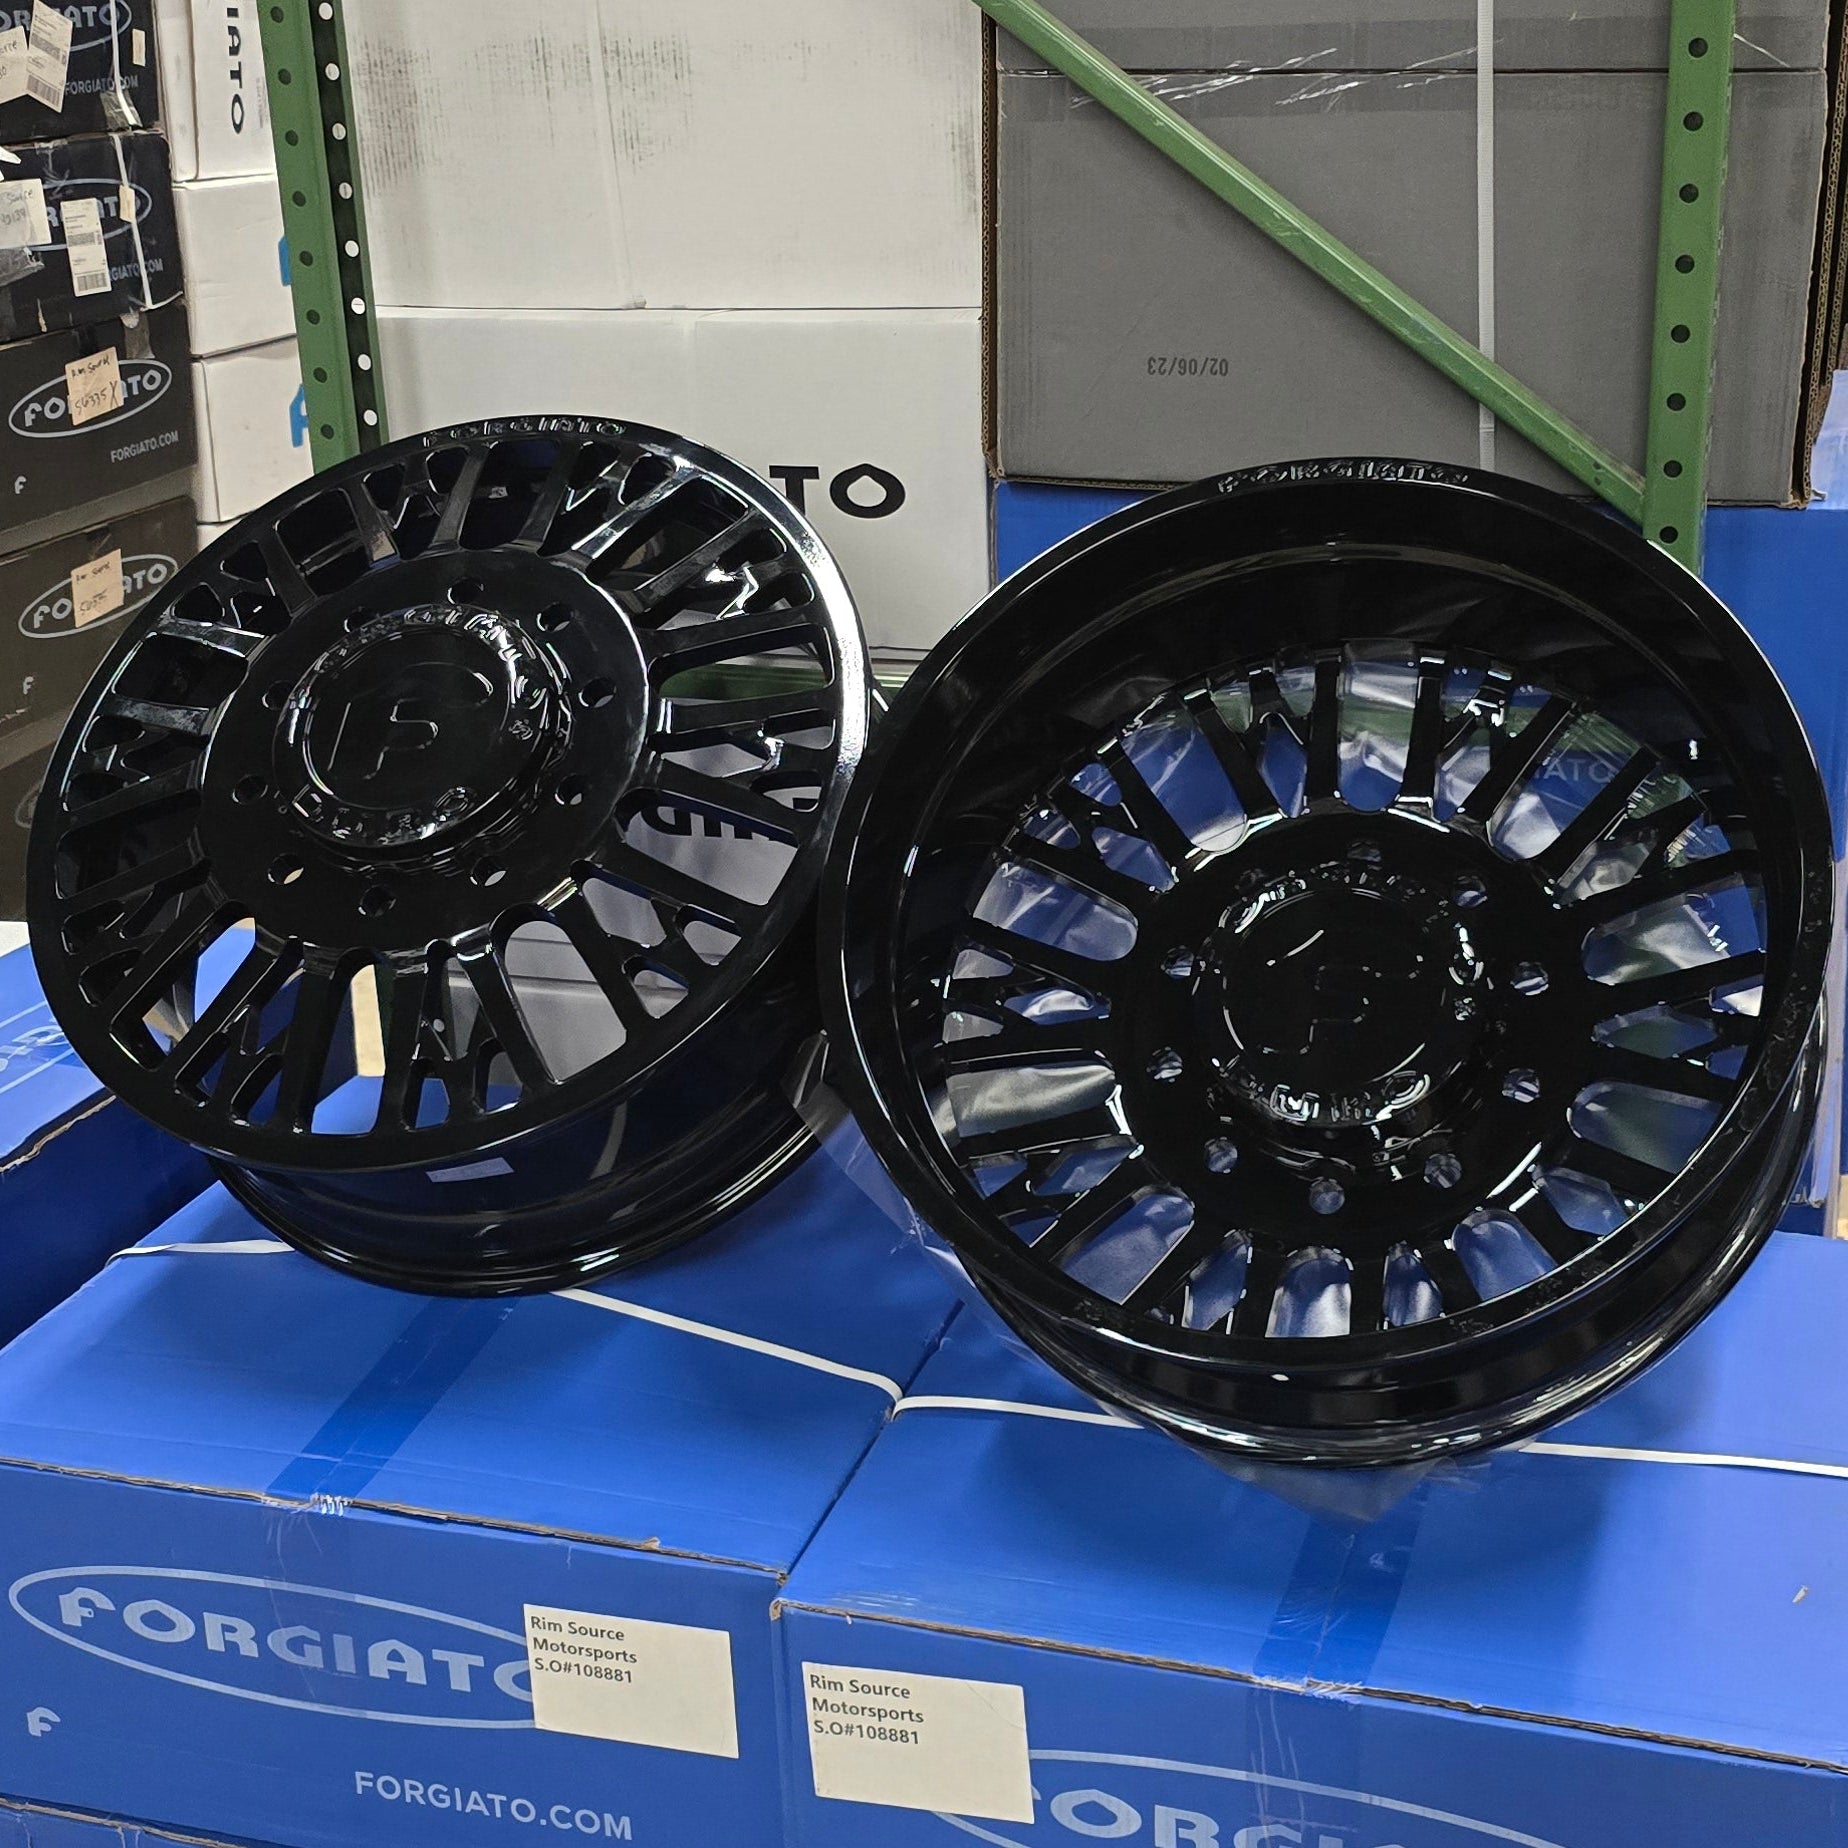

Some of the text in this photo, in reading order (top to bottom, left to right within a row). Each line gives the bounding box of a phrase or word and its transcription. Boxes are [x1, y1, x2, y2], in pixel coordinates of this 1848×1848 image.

[1147, 356, 1229, 377] 02/06/23
[110, 430, 179, 463] FORGIATO.COM
[14, 476, 27, 494] F
[22, 676, 34, 694] F
[530, 1615, 625, 1642] Rim Source
[532, 1636, 638, 1664] Motorsports
[534, 1657, 633, 1684] S.O#108881
[809, 1673, 911, 1700] Rim Source
[26, 1706, 61, 1737] F
[811, 1696, 925, 1724] Motorsports
[813, 1720, 920, 1745] S.O#108881
[354, 1771, 633, 1841] FORGIATO.COM
